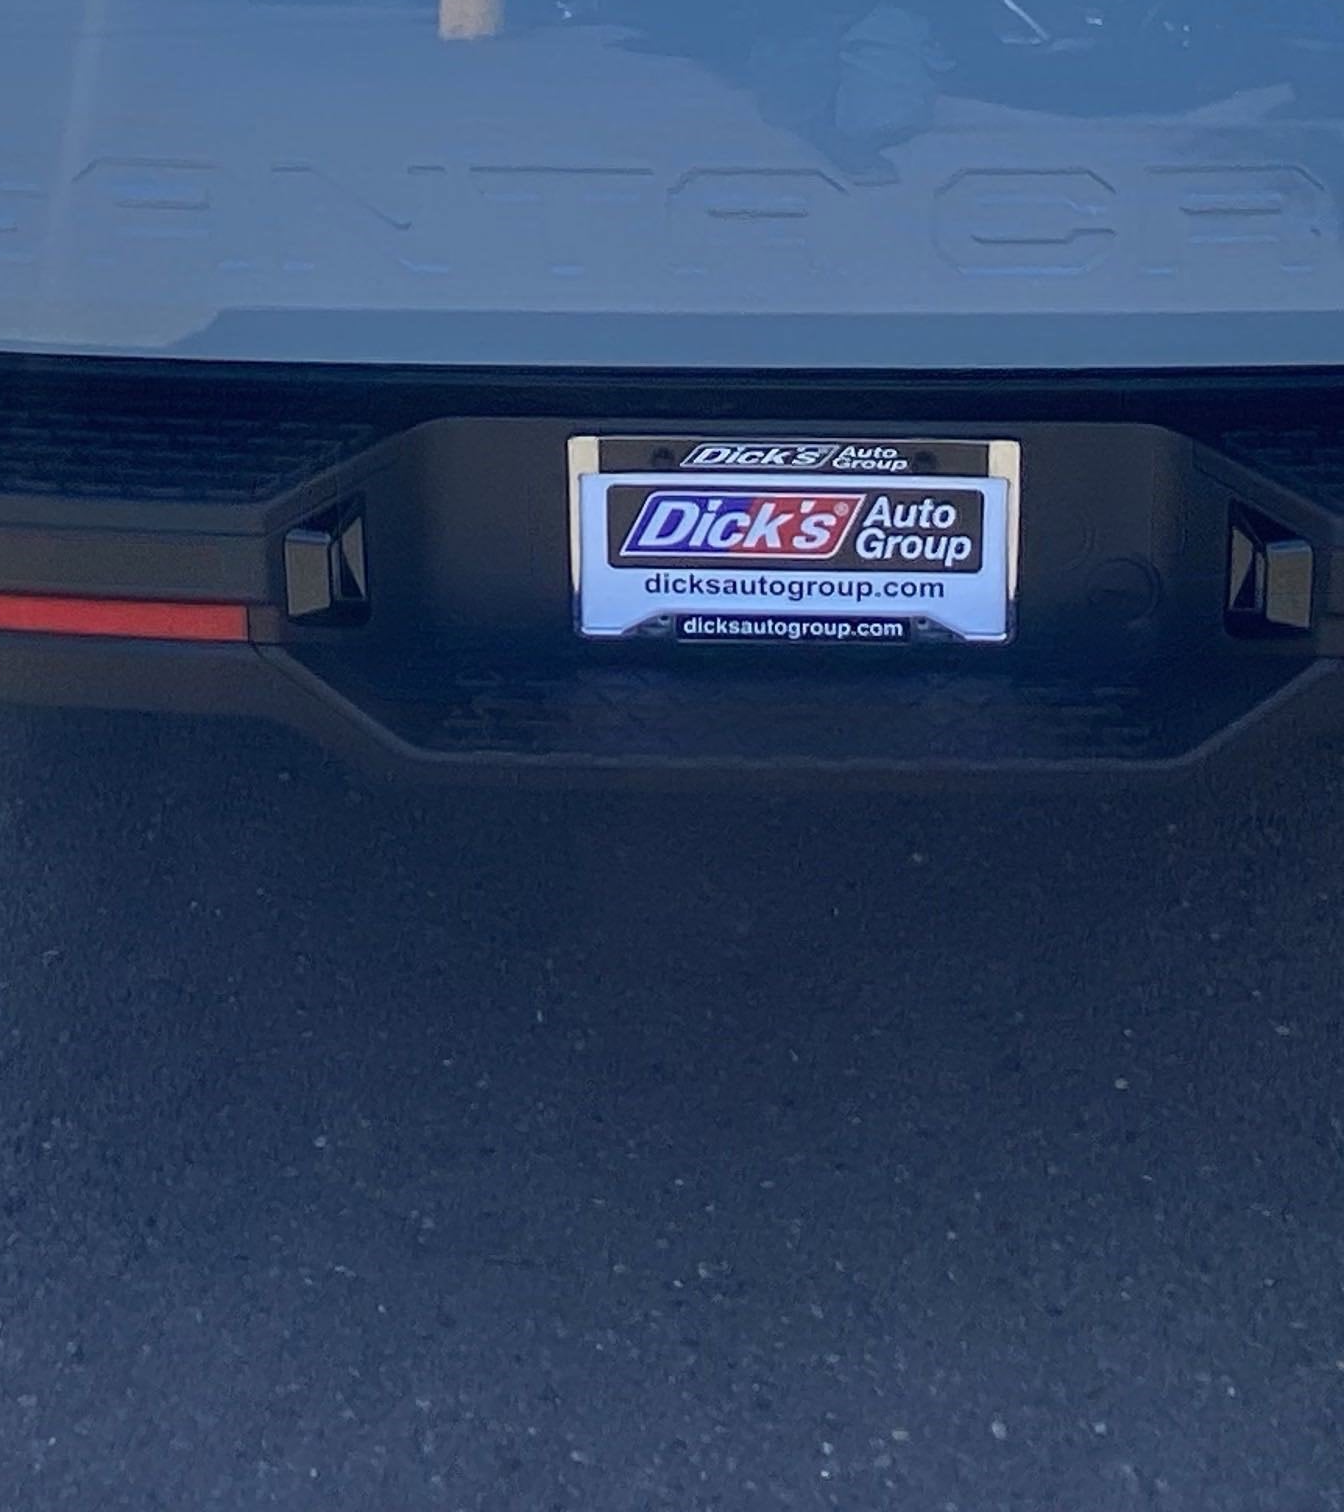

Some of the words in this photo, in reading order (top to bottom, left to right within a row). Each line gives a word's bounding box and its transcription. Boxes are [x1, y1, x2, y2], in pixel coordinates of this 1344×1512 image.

[692, 445, 823, 466] Dick's
[837, 445, 898, 460] Auto
[831, 457, 908, 472] Group
[637, 499, 837, 550] Dick's
[863, 496, 956, 529] Auto
[856, 526, 972, 567] Group
[644, 572, 946, 602] dicksautogroup.com
[682, 614, 904, 640] dicksautogroup.com
